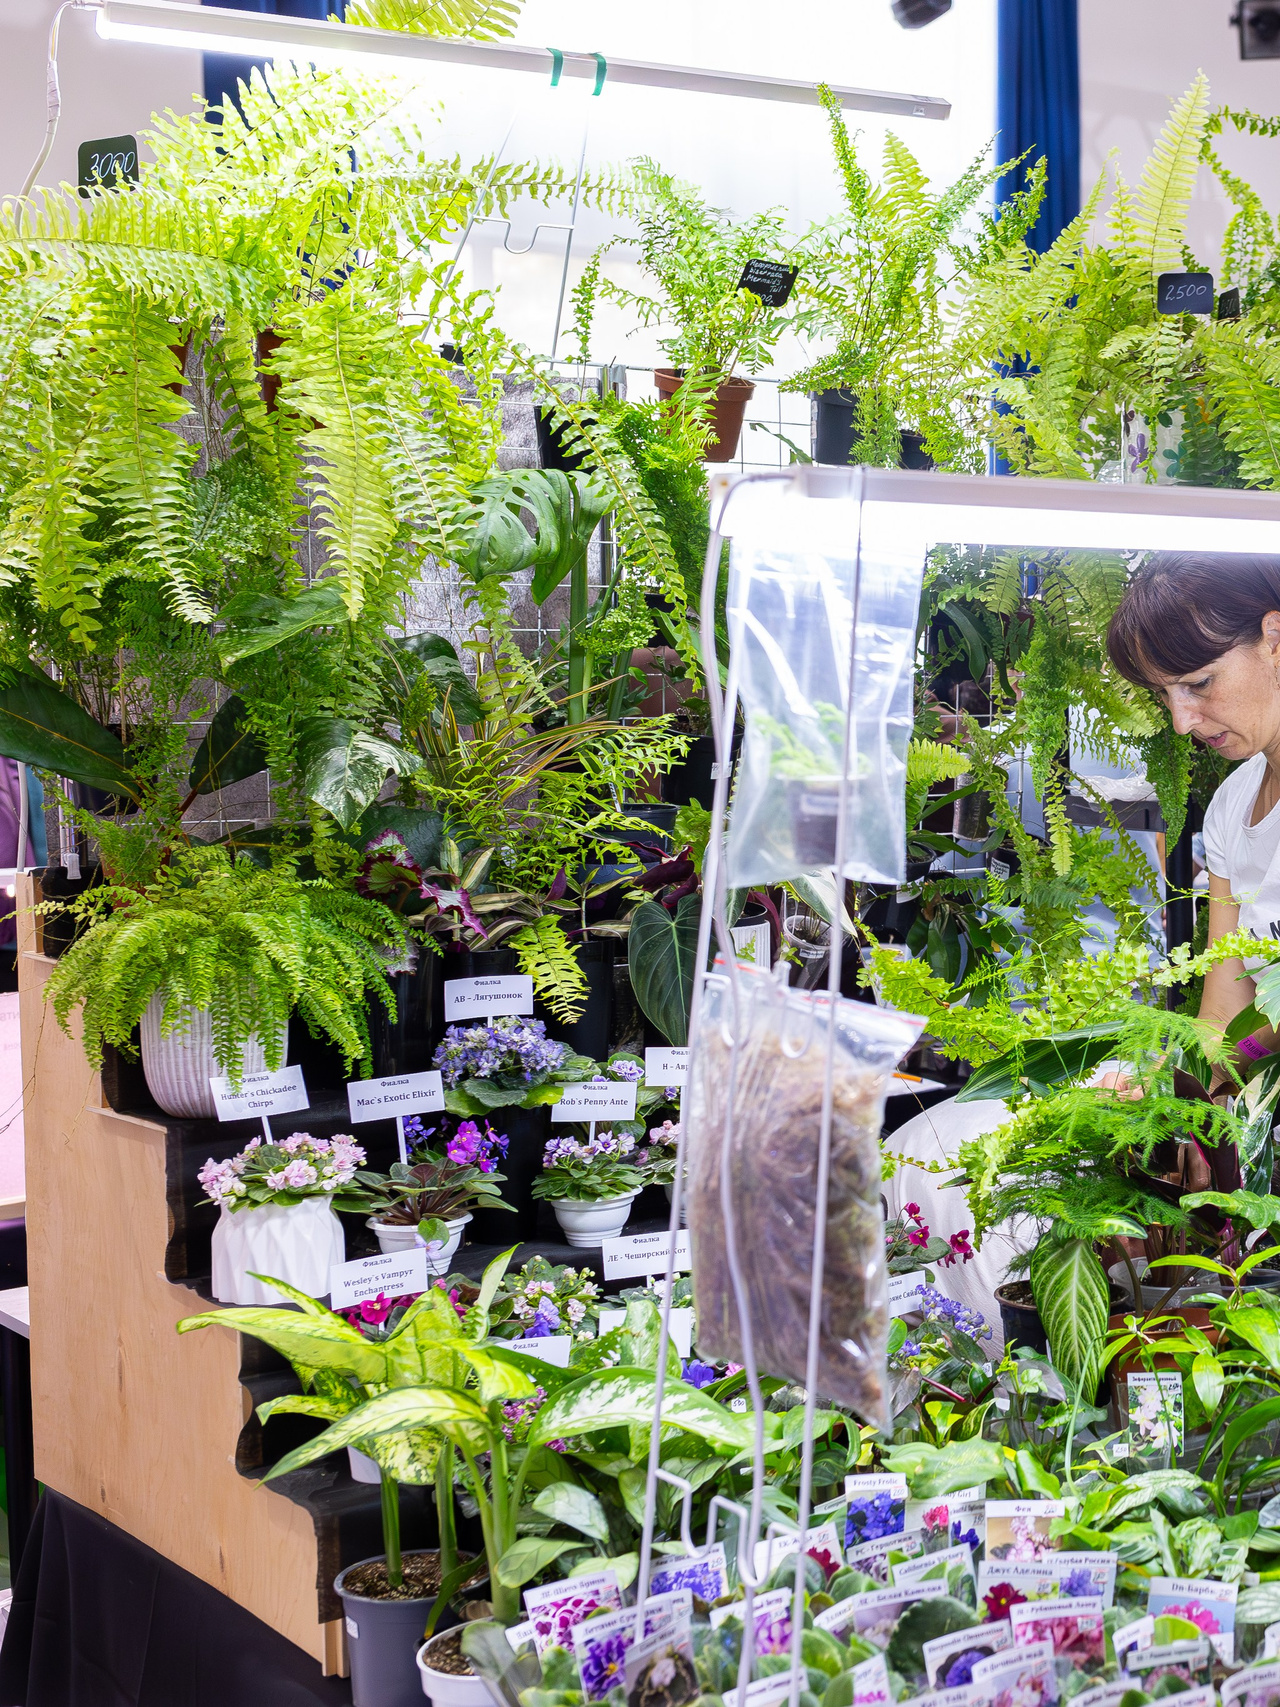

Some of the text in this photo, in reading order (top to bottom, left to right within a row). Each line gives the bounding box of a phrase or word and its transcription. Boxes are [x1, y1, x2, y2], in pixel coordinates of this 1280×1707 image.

[84, 151, 136, 181] 3000
[1165, 284, 1207, 301] 2500
[454, 995, 466, 1003] АВ
[473, 993, 523, 1002] Лягушонок
[241, 1075, 270, 1083] Фиалка
[380, 1078, 410, 1087] Фиалка
[255, 1084, 297, 1097] Chickadee
[383, 1093, 411, 1103] Exotic
[412, 1089, 437, 1098] Elixir
[248, 1099, 274, 1109] Chirps
[584, 1098, 608, 1107] Penny
[609, 1098, 629, 1106] Ante
[632, 1236, 660, 1245] Фиалка
[362, 1257, 393, 1267] Фиалка
[608, 1254, 619, 1263] ЛЕ
[381, 1268, 414, 1281] Vampyr
[353, 1281, 405, 1298] Enchantress
[512, 1342, 539, 1351] Фиалка
[1014, 1566, 1053, 1576] Аделина
